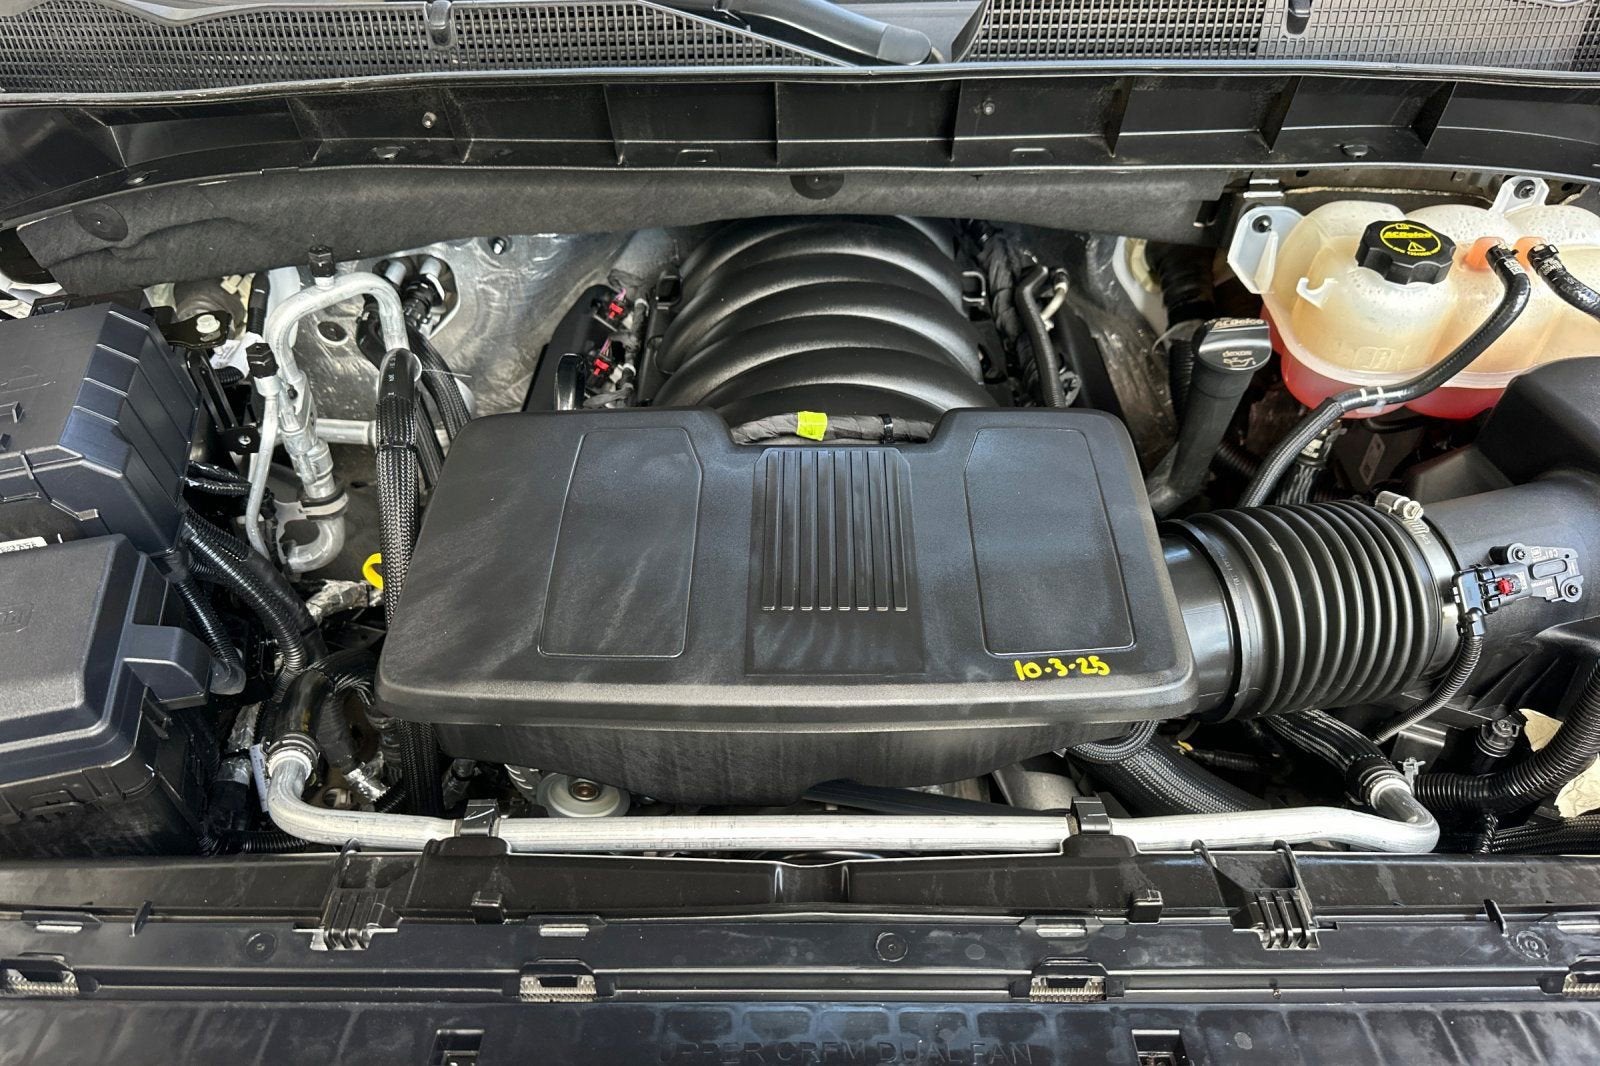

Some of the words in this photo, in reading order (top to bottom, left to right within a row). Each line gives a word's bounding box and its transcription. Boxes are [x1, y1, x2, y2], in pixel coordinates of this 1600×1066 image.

[1383, 231, 1433, 239] ACDelco
[1212, 317, 1265, 330] ACDelco
[878, 1041, 963, 1063] DUAL
[971, 1041, 1033, 1065] FAN
